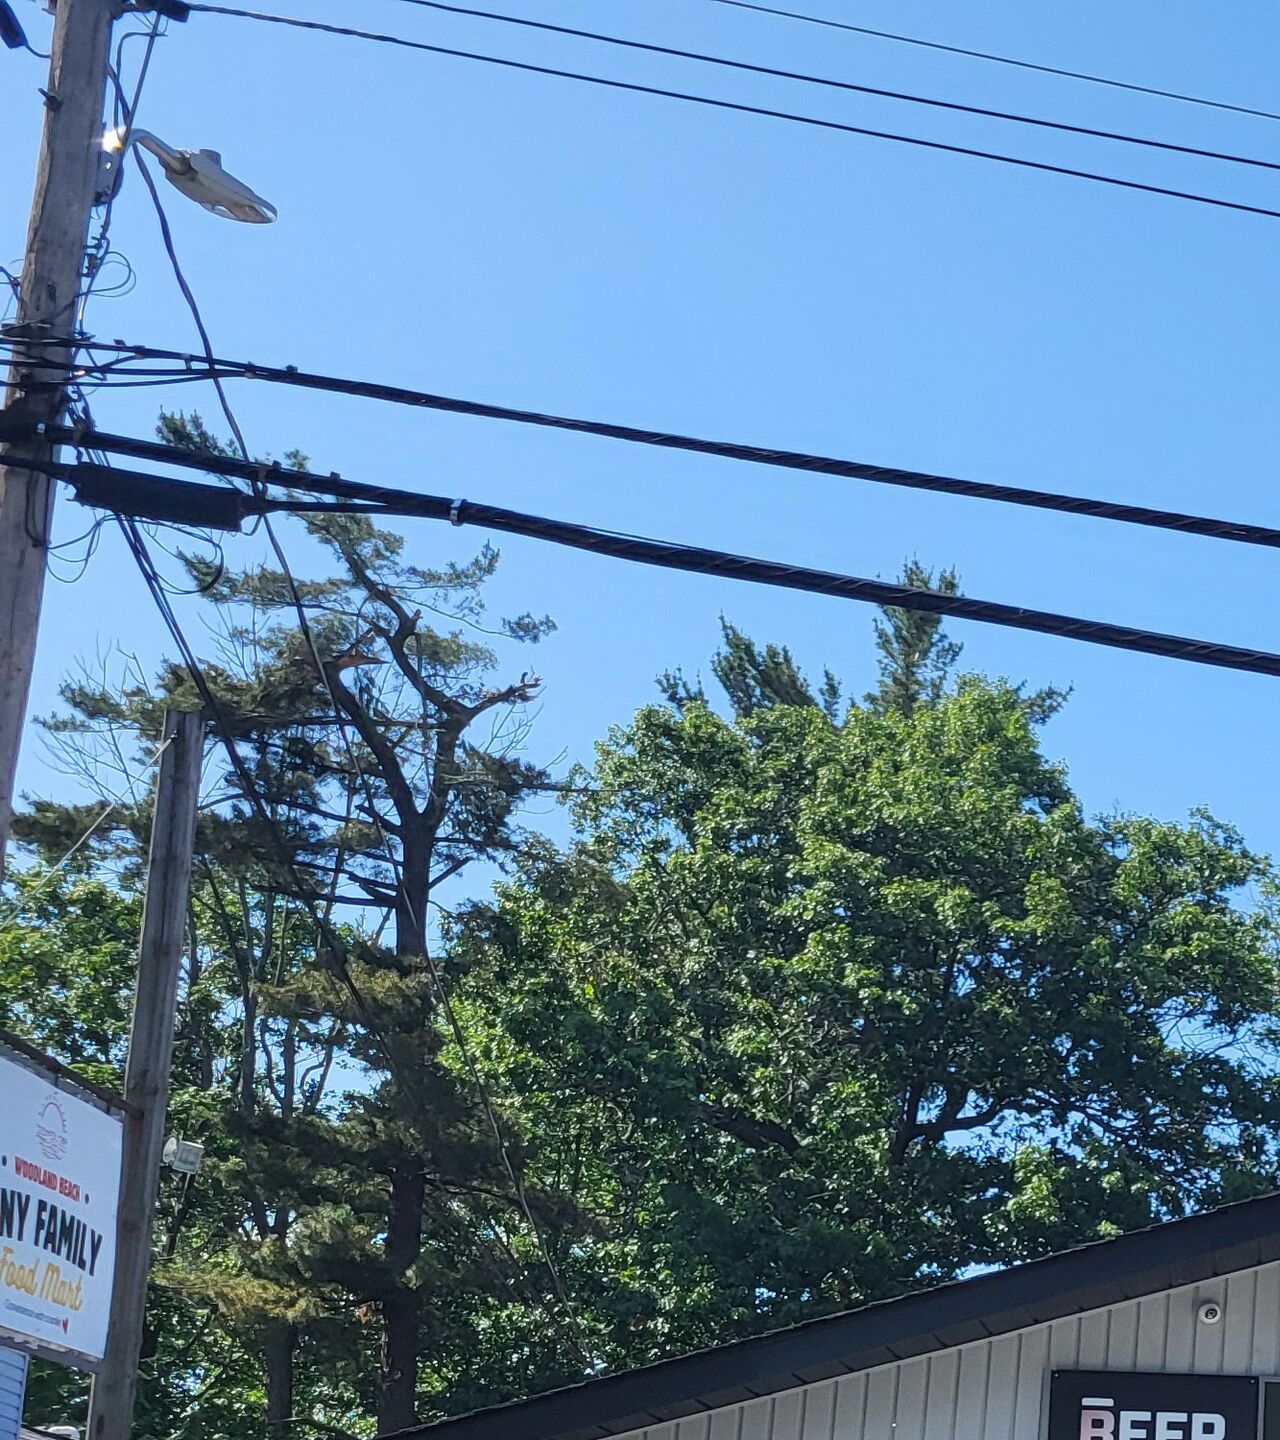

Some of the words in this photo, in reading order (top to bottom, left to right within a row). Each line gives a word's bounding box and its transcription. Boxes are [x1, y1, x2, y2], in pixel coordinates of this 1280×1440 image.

[14, 1155, 58, 1191] WOODLAND
[59, 1176, 80, 1203] BEACH
[34, 1199, 103, 1277] FAMILY
